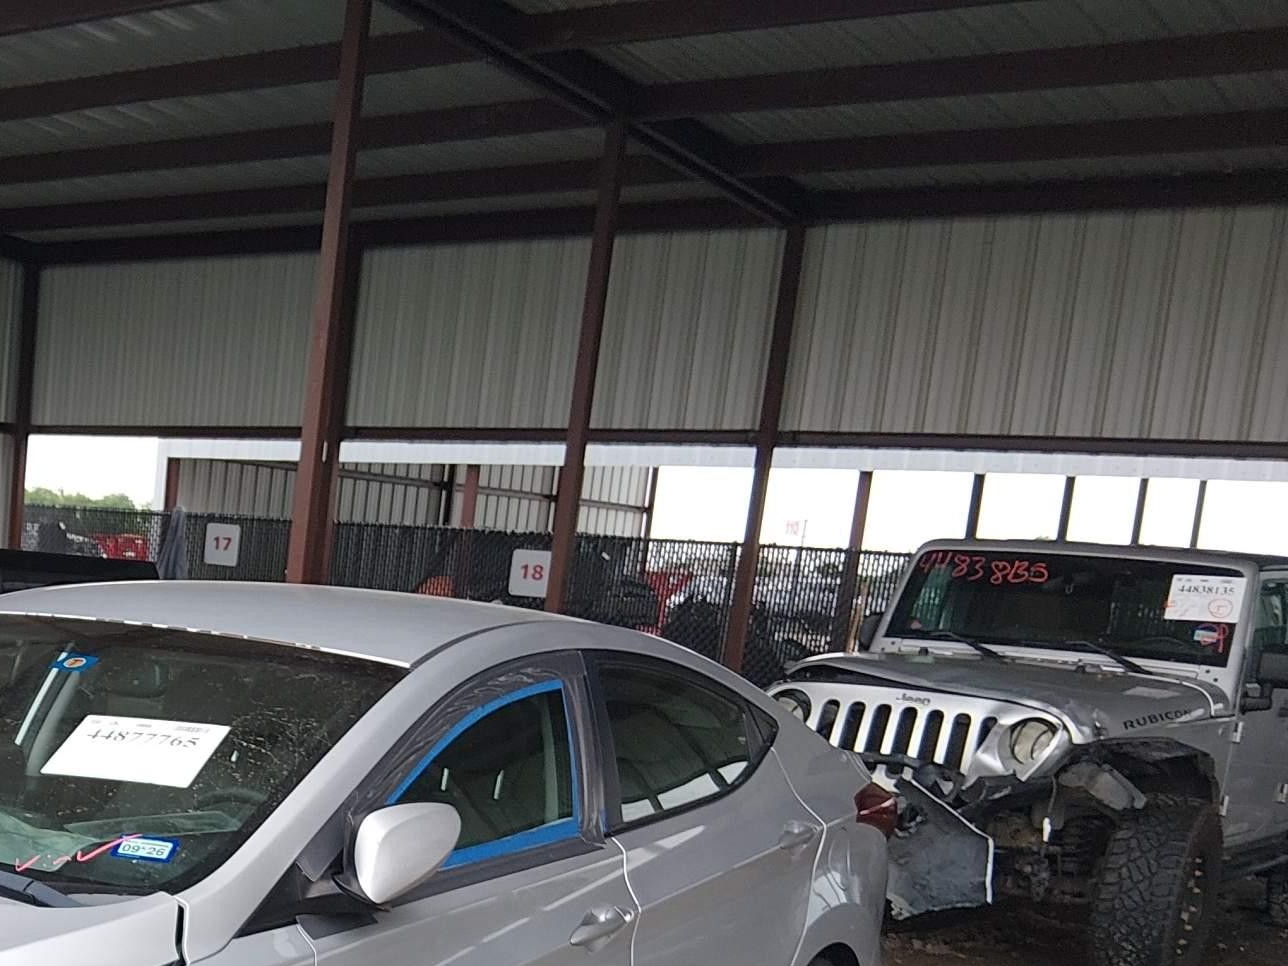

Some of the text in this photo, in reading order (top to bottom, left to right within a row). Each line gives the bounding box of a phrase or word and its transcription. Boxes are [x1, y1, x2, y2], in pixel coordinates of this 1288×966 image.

[214, 536, 232, 551] 17
[521, 564, 544, 581] 18
[87, 728, 201, 748] 44877765
